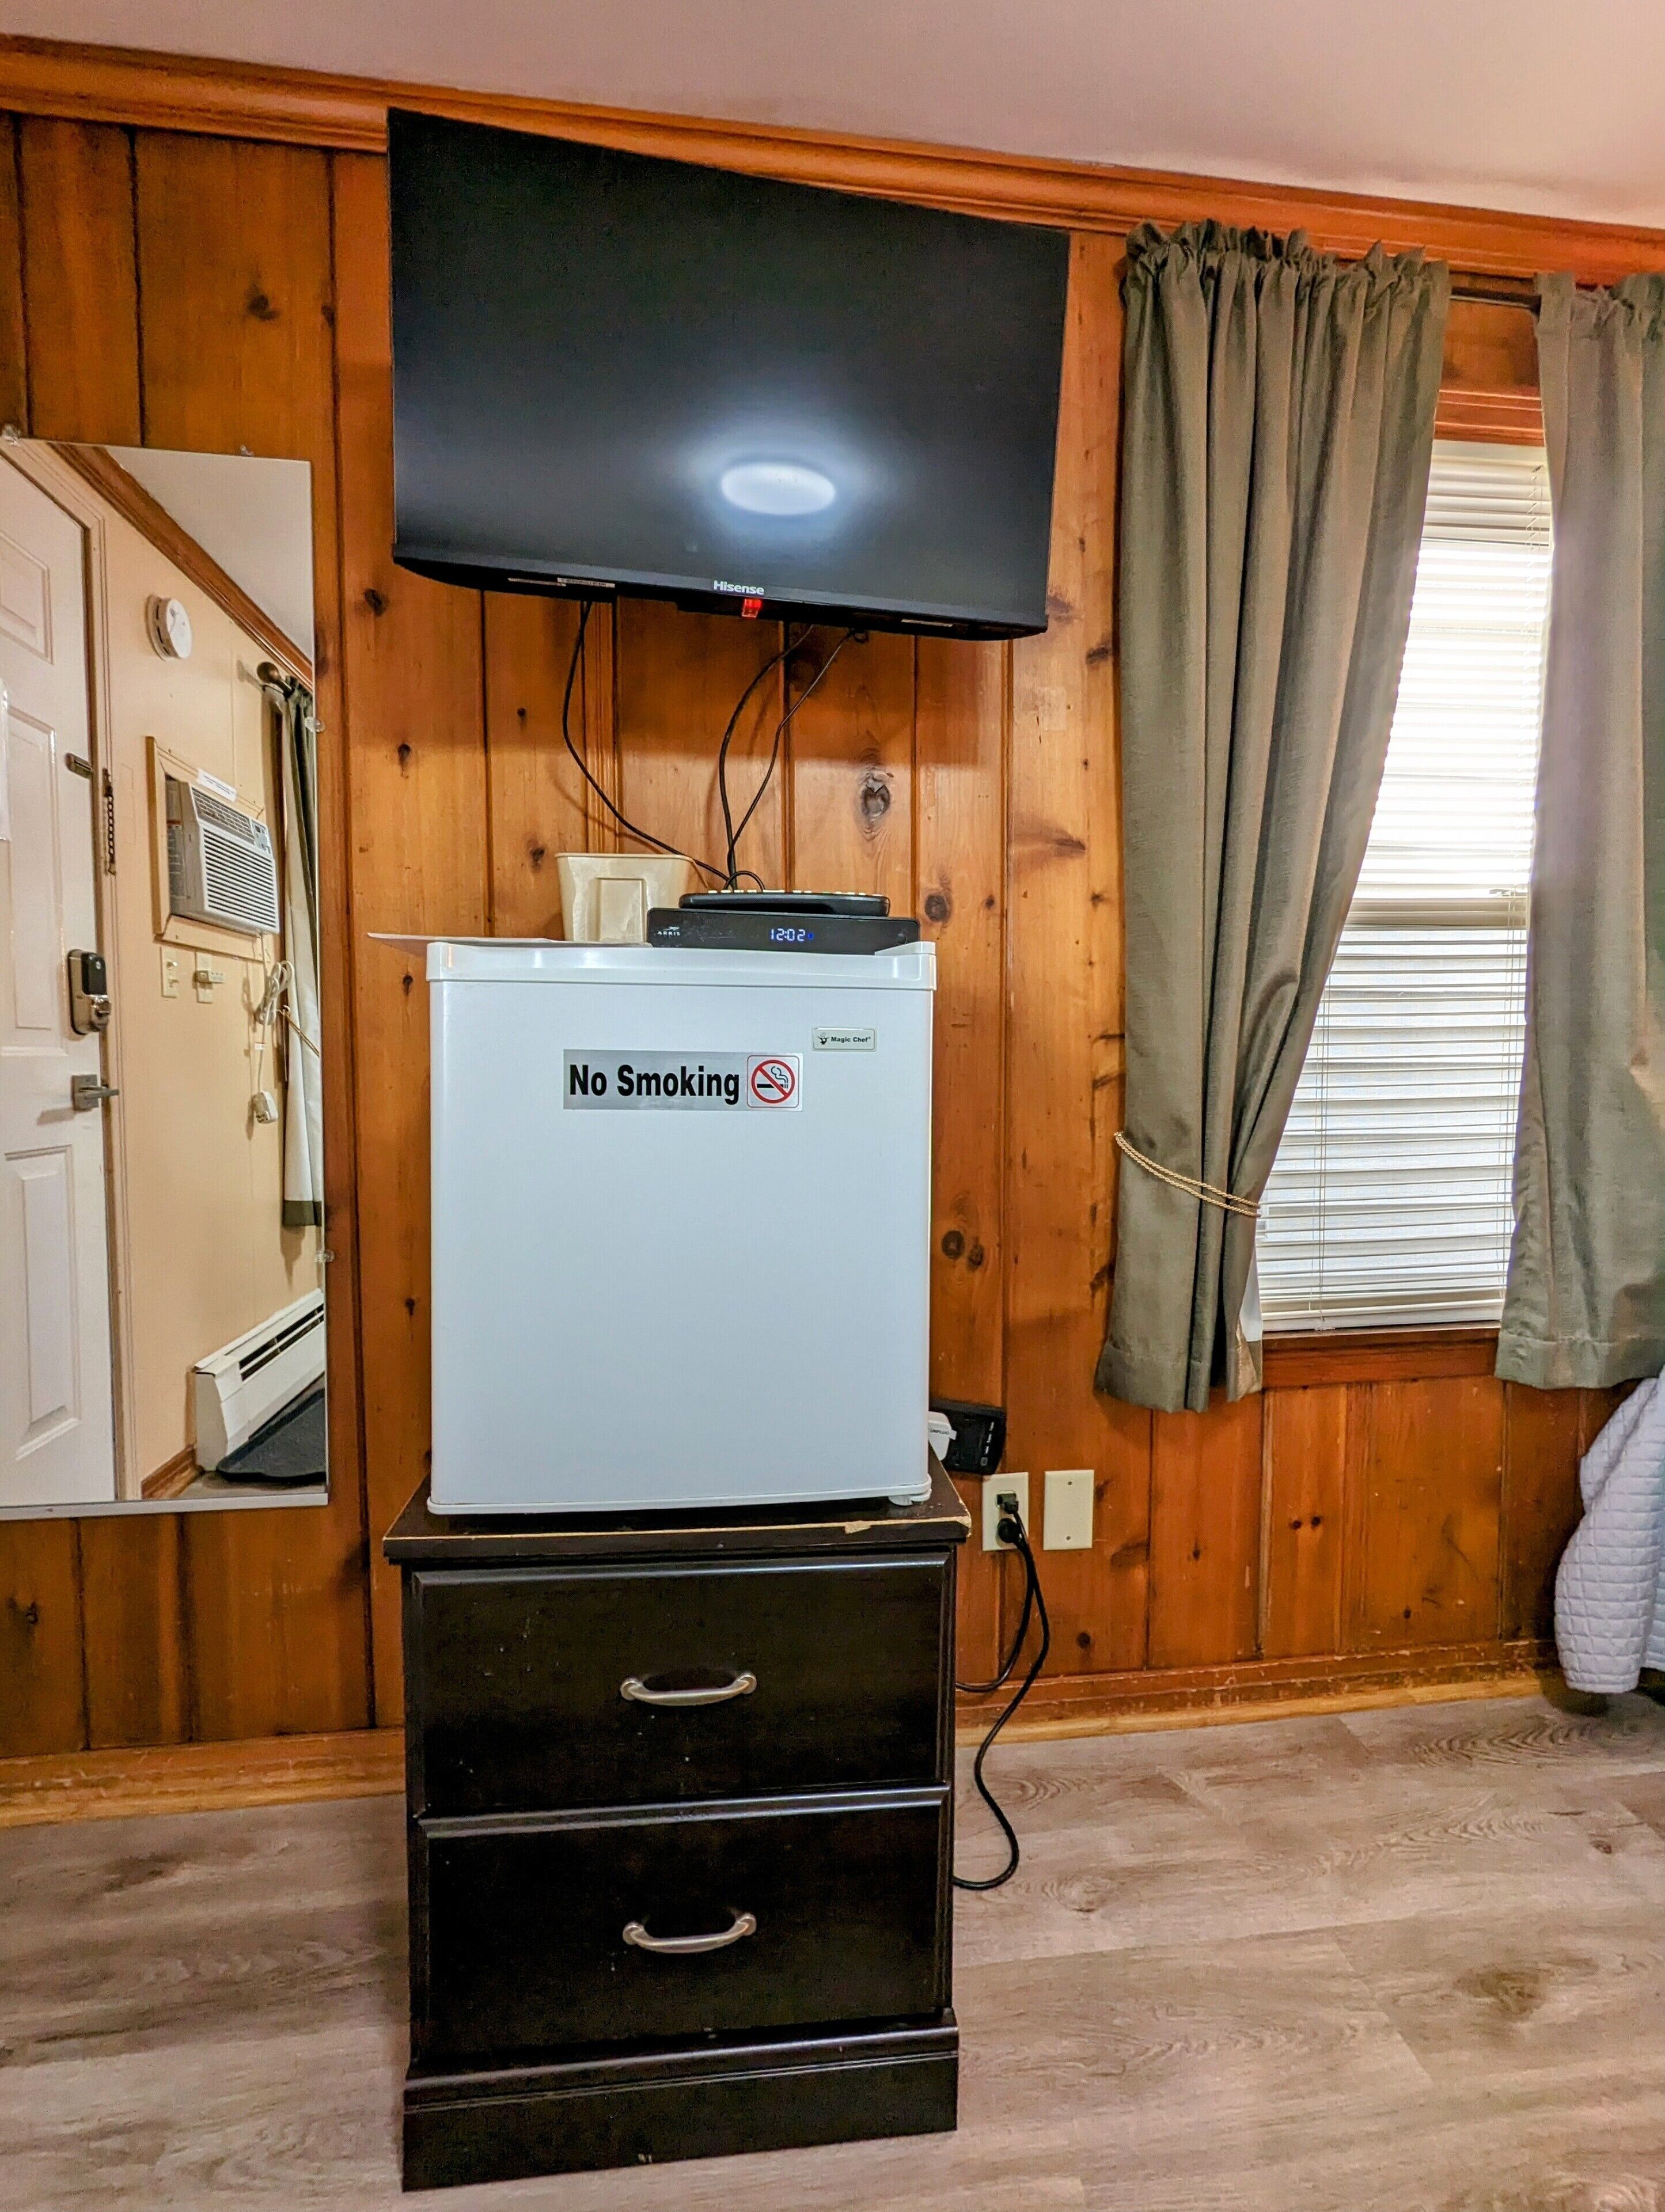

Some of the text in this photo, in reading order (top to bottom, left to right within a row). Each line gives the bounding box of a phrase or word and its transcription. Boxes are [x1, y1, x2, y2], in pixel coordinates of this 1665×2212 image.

[714, 580, 765, 595] Hisense
[771, 929, 805, 941] 12:02
[570, 1065, 740, 1105] No Smoking
